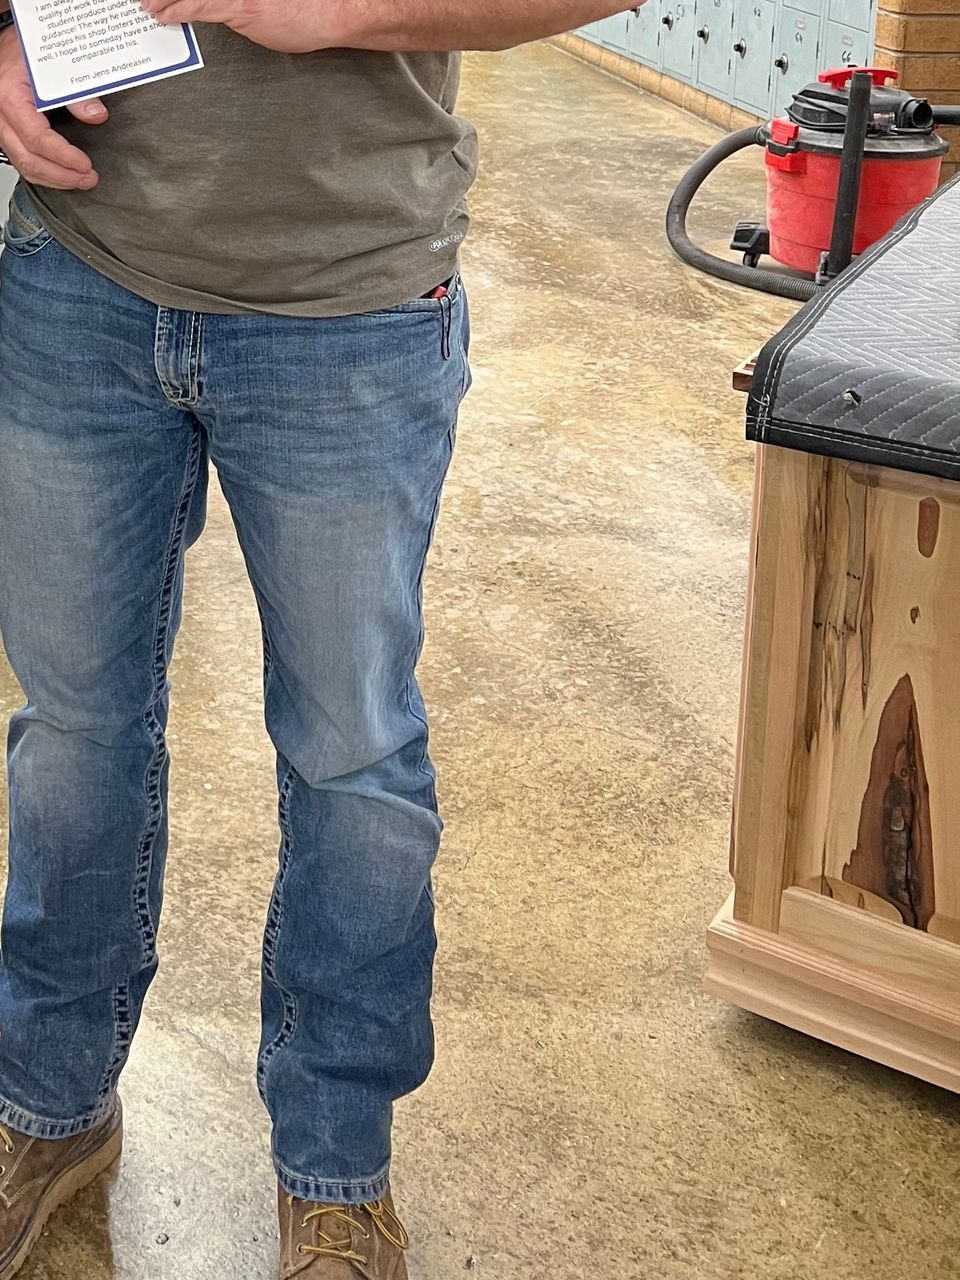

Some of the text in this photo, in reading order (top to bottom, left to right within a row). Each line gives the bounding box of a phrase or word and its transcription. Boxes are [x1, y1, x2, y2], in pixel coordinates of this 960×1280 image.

[38, 10, 63, 22] quality
[64, 5, 71, 14] of
[73, 0, 91, 11] work
[40, 3, 52, 11] am
[47, 16, 75, 29] student
[76, 7, 106, 22] produce
[107, 0, 128, 11] under
[77, 22, 92, 30] The
[93, 17, 108, 25] way
[120, 8, 137, 17] runs
[39, 37, 74, 51] manages
[74, 33, 87, 41] his
[87, 28, 107, 38] shop
[107, 19, 134, 31] fosters
[134, 14, 149, 24] this
[58, 46, 78, 56] hope
[79, 43, 88, 51] to
[88, 34, 122, 49] someday
[123, 28, 142, 38] have
[71, 40, 139, 64] comparable to his.
[841, 50, 851, 63] 66
[70, 56, 152, 85] From Jens Andreasen
